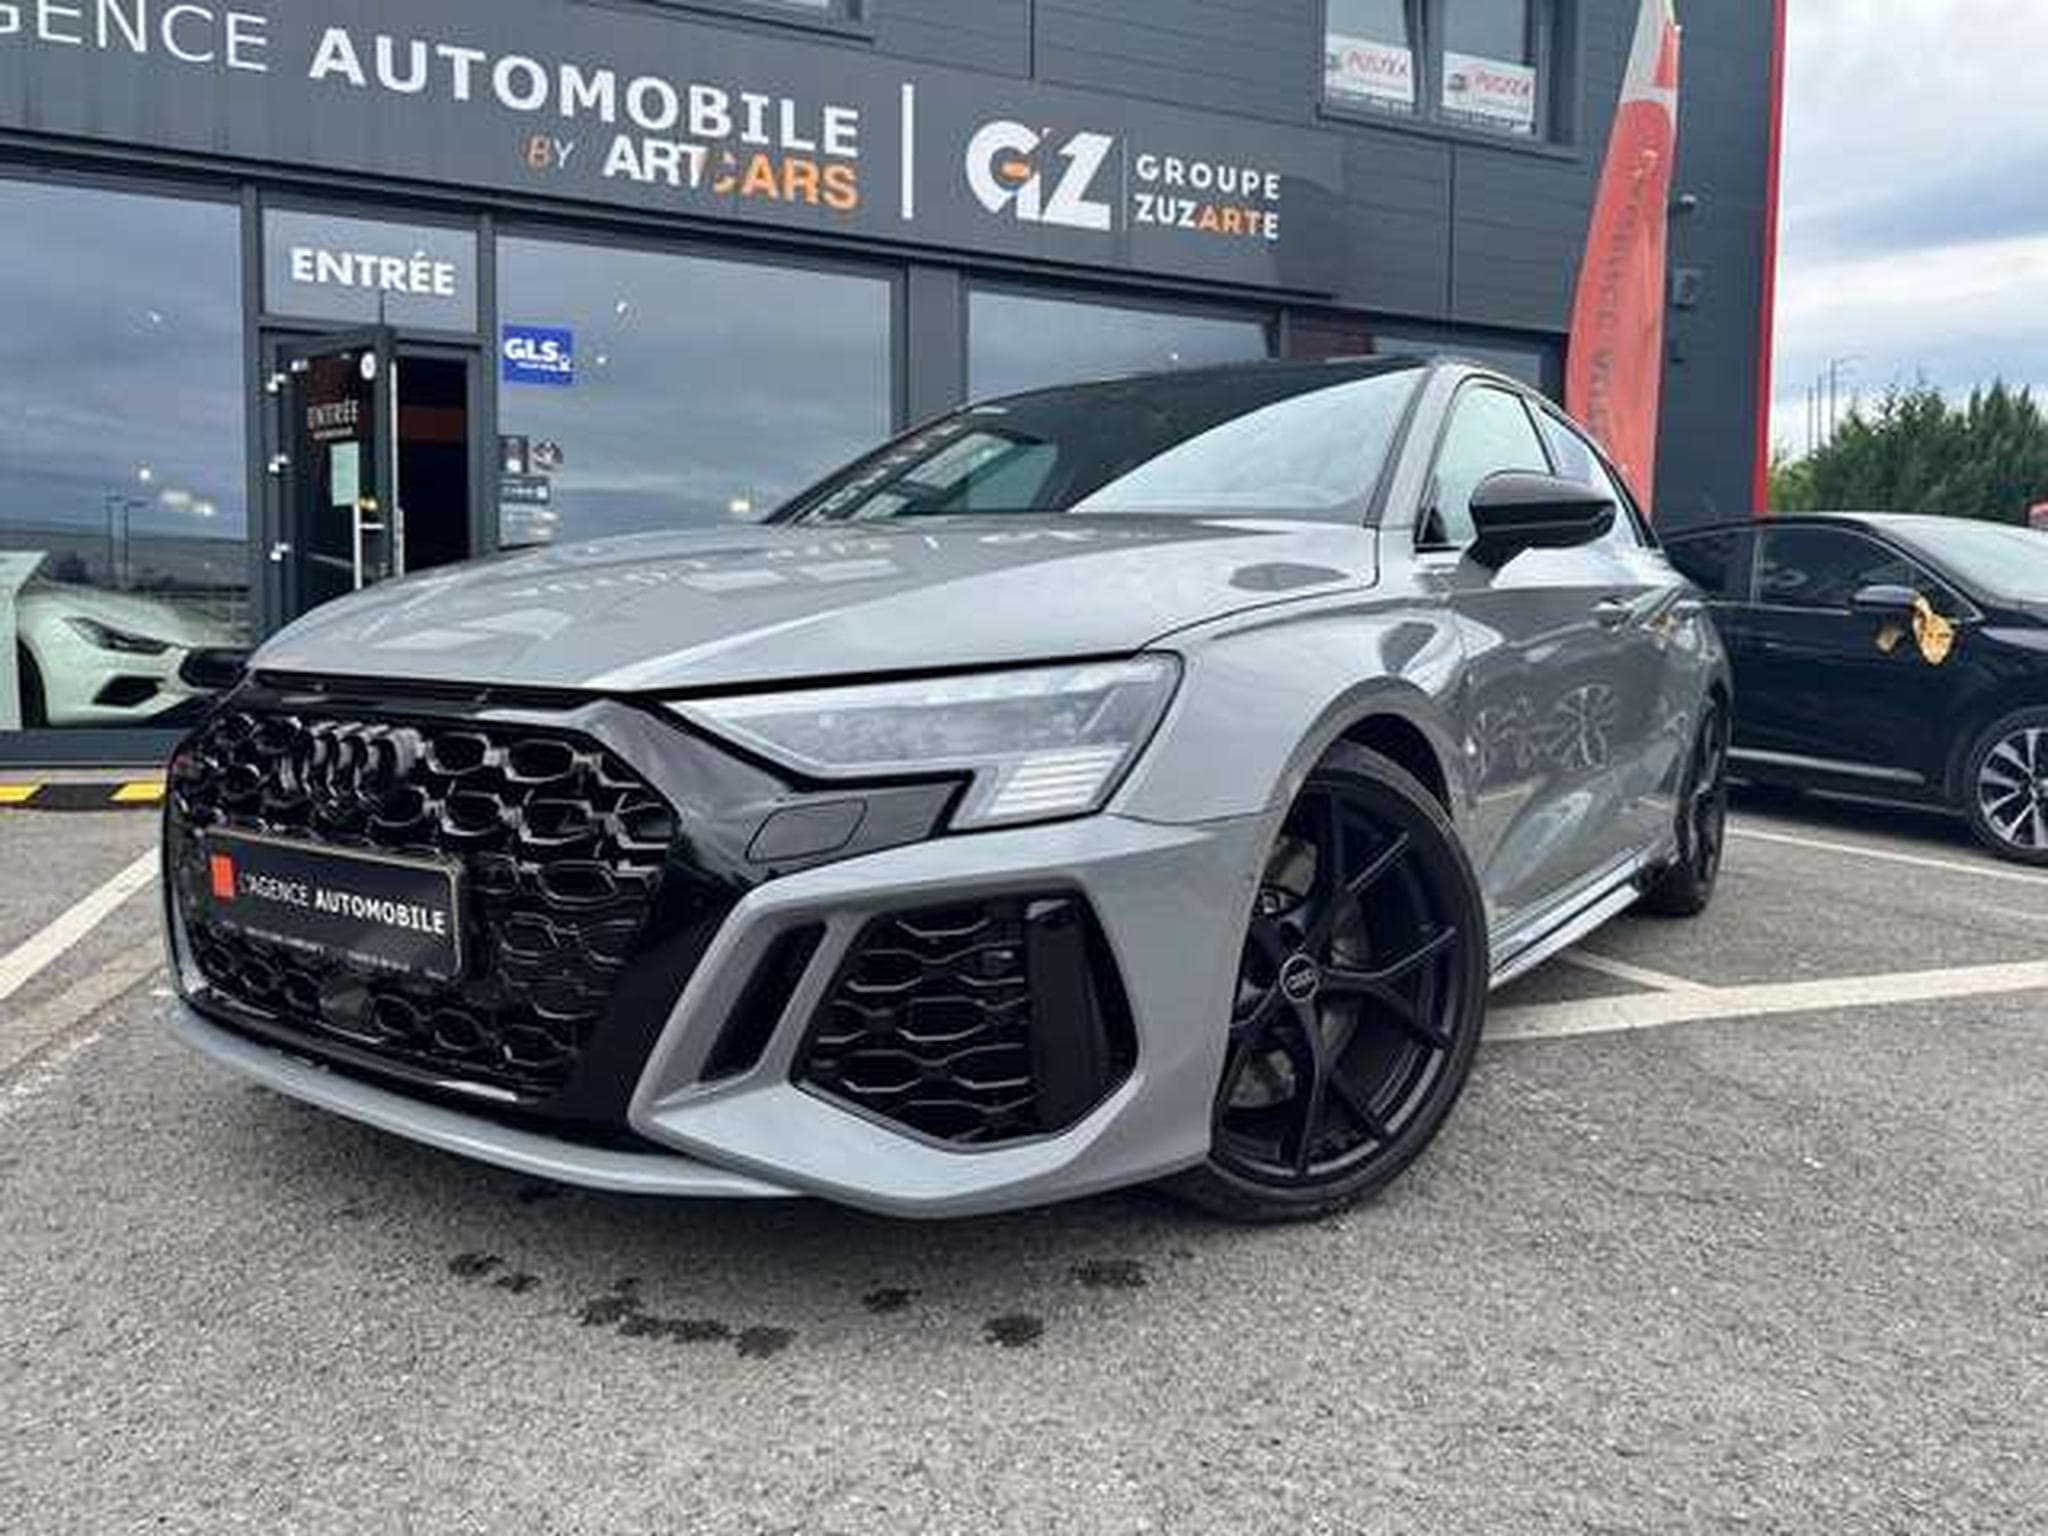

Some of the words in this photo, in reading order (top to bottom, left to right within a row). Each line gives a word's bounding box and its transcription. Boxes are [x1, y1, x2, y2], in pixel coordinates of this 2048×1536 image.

[308, 27, 859, 158] AUTOMOBILE
[527, 134, 576, 169] BY
[1135, 154, 1281, 200] GROUPE
[1134, 193, 1280, 240] ZUZARTE
[291, 247, 456, 295] ENTRÉE
[504, 337, 559, 363] GLS
[315, 888, 446, 935] AUTOMOBILE
